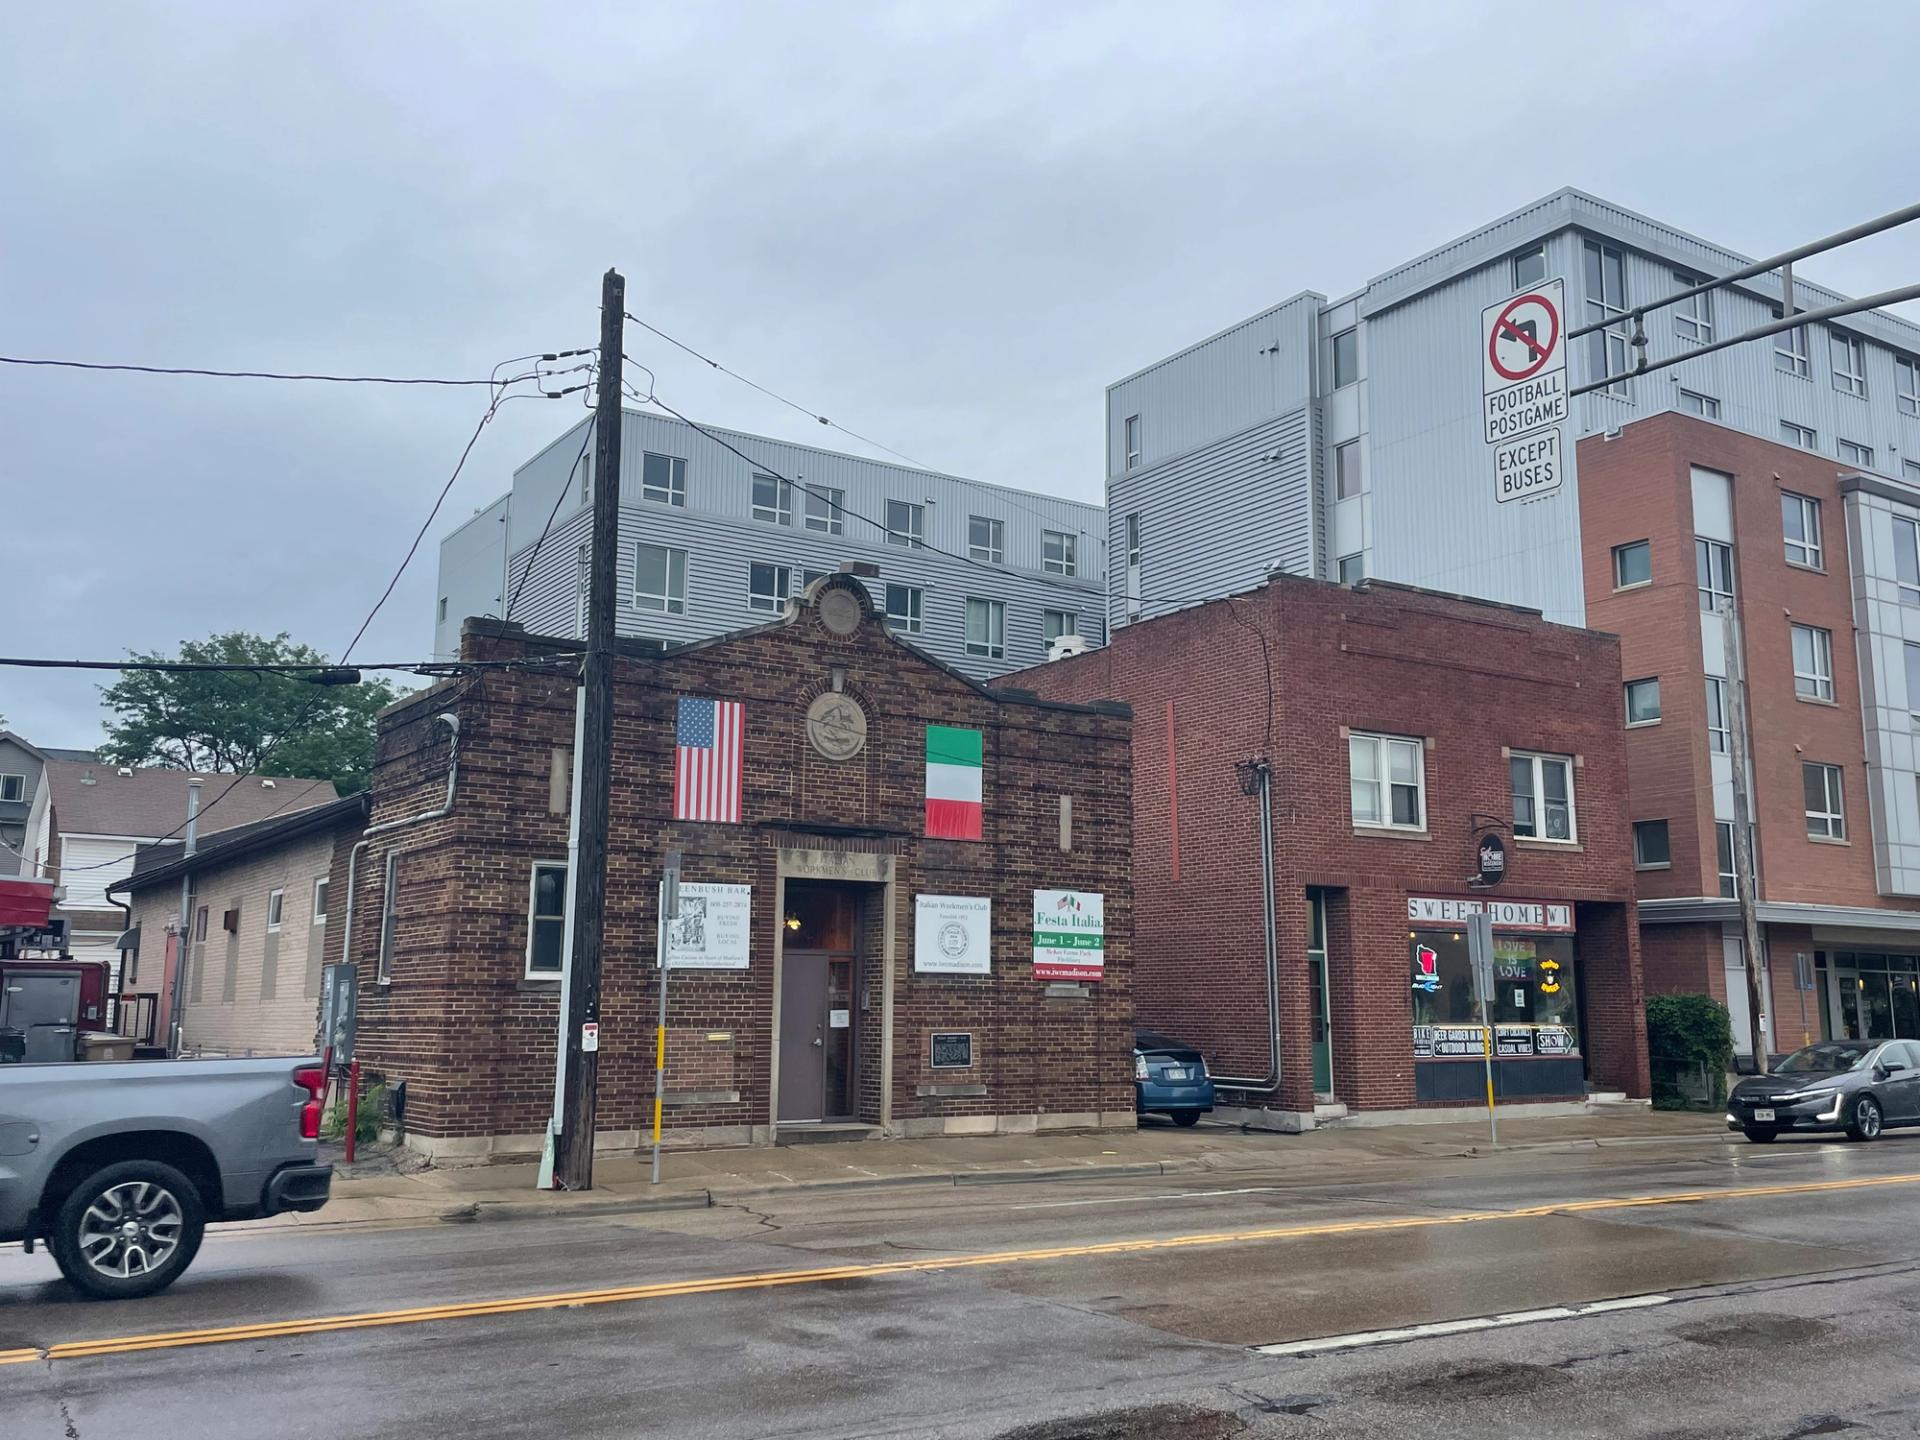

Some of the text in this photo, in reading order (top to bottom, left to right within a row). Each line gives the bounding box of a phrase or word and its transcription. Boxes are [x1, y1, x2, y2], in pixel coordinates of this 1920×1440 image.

[1490, 376, 1561, 415] FOOTBALL
[1490, 398, 1563, 438] POSTGAME
[1499, 437, 1555, 471] EXCEPT
[1503, 462, 1553, 493] BUSES
[680, 885, 747, 895] EENBUSH BAR
[920, 901, 988, 911] Italian Workmen's Club
[1409, 900, 1568, 925] SWEET HOME WI
[1037, 911, 1101, 928] Festa Italia
[1037, 934, 1056, 945] June
[1060, 935, 1065, 945] 1
[1073, 936, 1092, 947] June
[1094, 938, 1100, 947] 2
[1498, 941, 1525, 952] LOVE
[1507, 956, 1517, 965] IS
[1035, 967, 1102, 978] www.iwcmadison.com
[1499, 966, 1527, 978] LOVE
[1413, 1028, 1431, 1039] BIKE
[1434, 1030, 1448, 1041] BEER
[1448, 1029, 1470, 1041] GARDEN
[1539, 1035, 1564, 1047] SHOW
[1441, 1042, 1466, 1053] OUTDOOR
[1498, 1043, 1517, 1053] CASUAL
